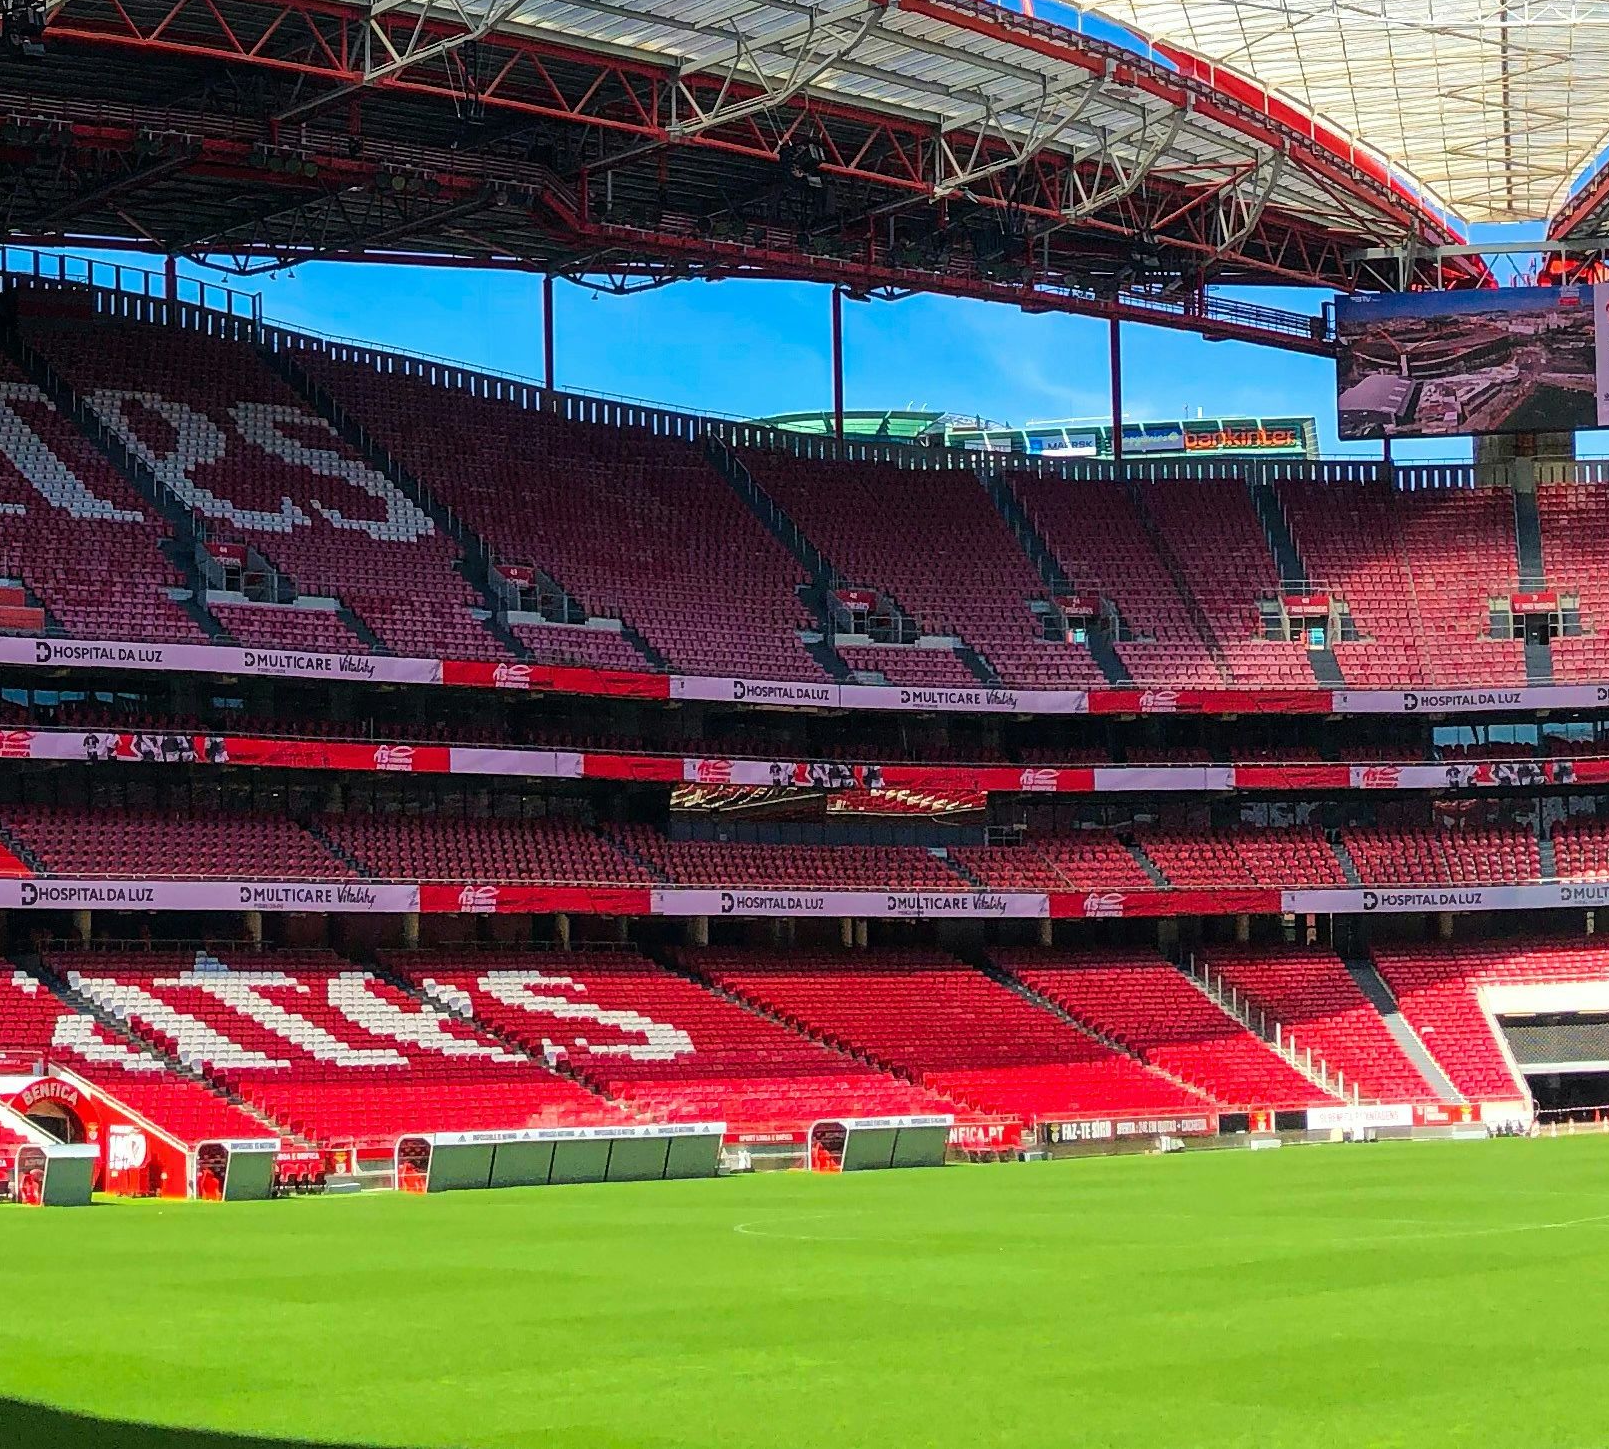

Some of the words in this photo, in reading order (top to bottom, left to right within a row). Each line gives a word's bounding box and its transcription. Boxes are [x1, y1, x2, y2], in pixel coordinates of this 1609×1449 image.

[1184, 425, 1298, 449] bankinter
[53, 645, 115, 660] HOSPITAL
[118, 648, 136, 661] DA
[139, 649, 162, 662] LUZ
[257, 655, 331, 670] MULTICARE
[339, 654, 375, 677] Vitality
[747, 685, 794, 698] HOSPITAL
[797, 687, 811, 699] DA
[811, 688, 829, 700] LUZ
[913, 692, 980, 704] MULTICARE
[986, 689, 1017, 709] Vitality
[1421, 695, 1477, 706] HOSPITAL
[1478, 694, 1495, 704] DA
[1498, 693, 1521, 704] LUZ
[39, 887, 106, 901] HOSPITAL
[107, 888, 126, 901] DA
[129, 888, 153, 902] LUZ
[254, 890, 331, 903] MULTICARE
[337, 886, 376, 909] Vitality
[737, 897, 787, 909] HOSPITAL
[788, 897, 802, 909] DA
[805, 897, 823, 909] LUZ
[898, 897, 968, 909] MULTICARE
[973, 894, 1007, 913] Vitality
[1382, 895, 1438, 905] HOSPITAL
[1439, 894, 1458, 904] DA
[1458, 893, 1482, 904] LUZ
[21, 1083, 79, 1106] BENFICA
